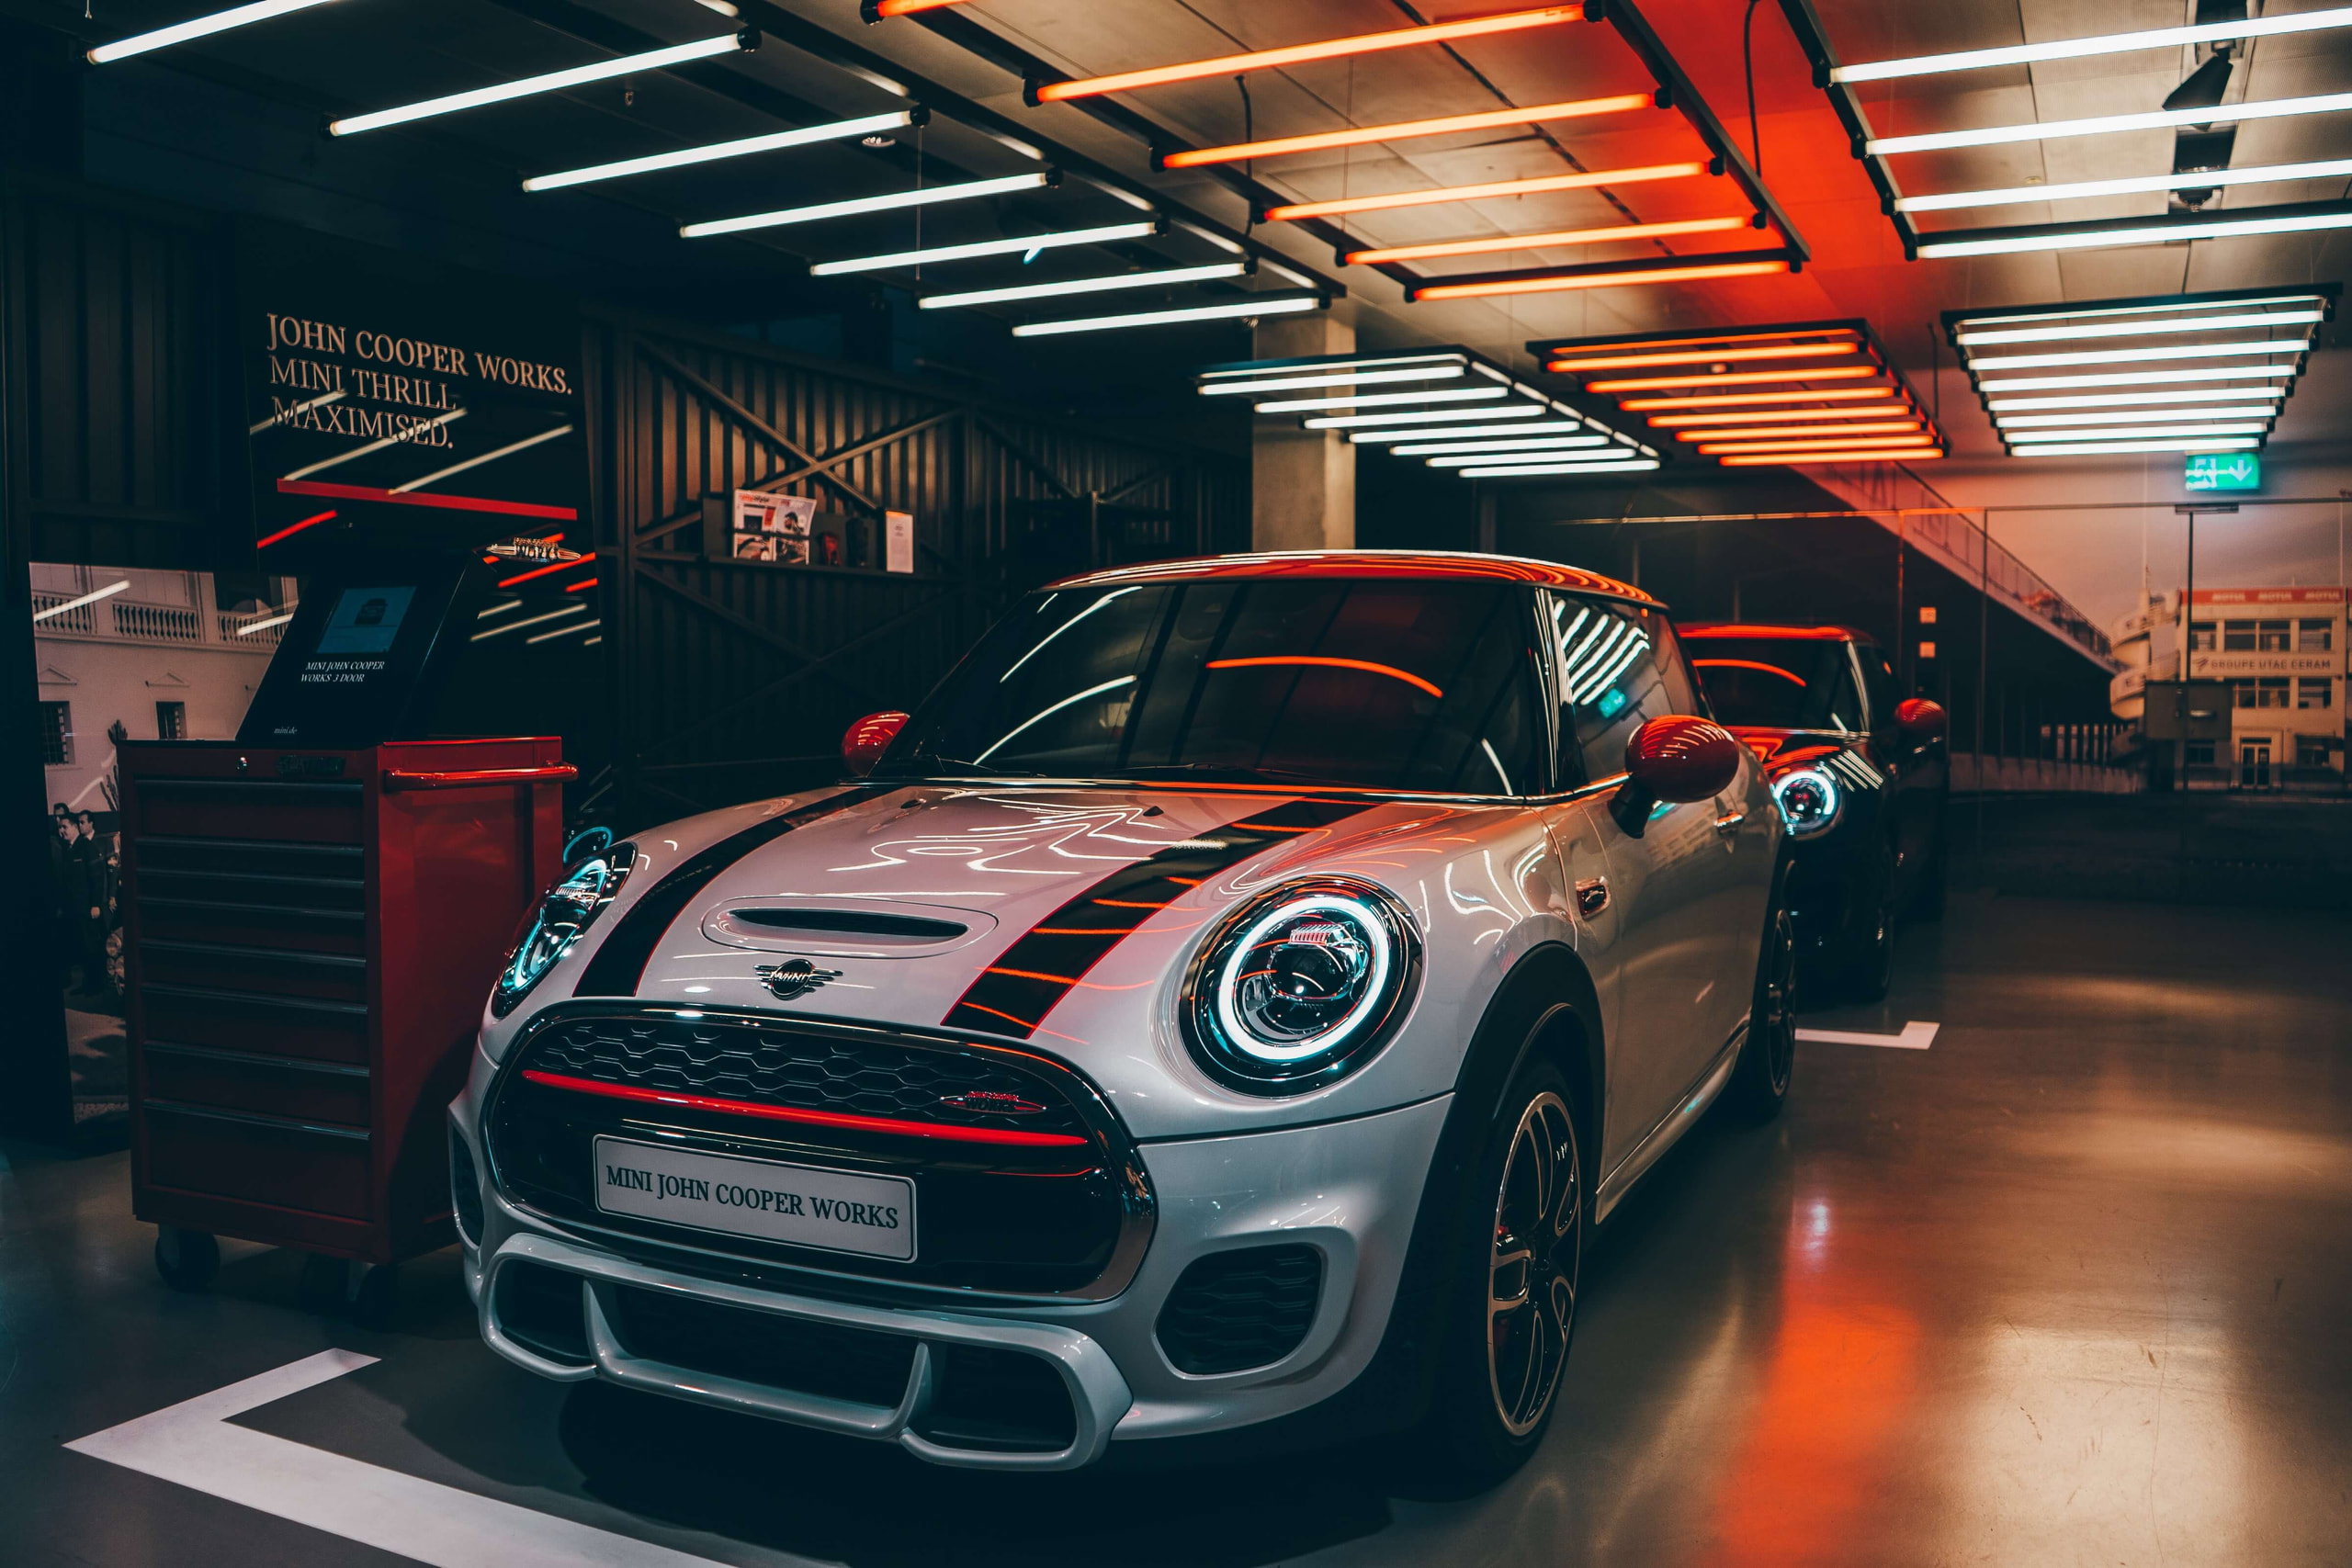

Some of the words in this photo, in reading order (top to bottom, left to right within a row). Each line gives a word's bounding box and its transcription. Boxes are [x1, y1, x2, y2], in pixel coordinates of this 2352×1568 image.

[266, 312, 346, 355] JOHN
[355, 330, 469, 378] COOPER
[474, 352, 573, 396] WORKS.
[269, 355, 345, 392] MINI
[351, 367, 458, 412] THRILL
[271, 396, 455, 450] MAXIMISED.
[300, 673, 332, 682] WORKS
[339, 673, 365, 682] DOOR
[305, 661, 327, 671] MINI
[325, 661, 349, 672] JOHN
[350, 661, 385, 671] COOPER
[605, 1165, 653, 1192] MINI
[657, 1173, 710, 1201] JOHN
[716, 1182, 806, 1217] COOPER
[809, 1196, 899, 1230] WORKS
